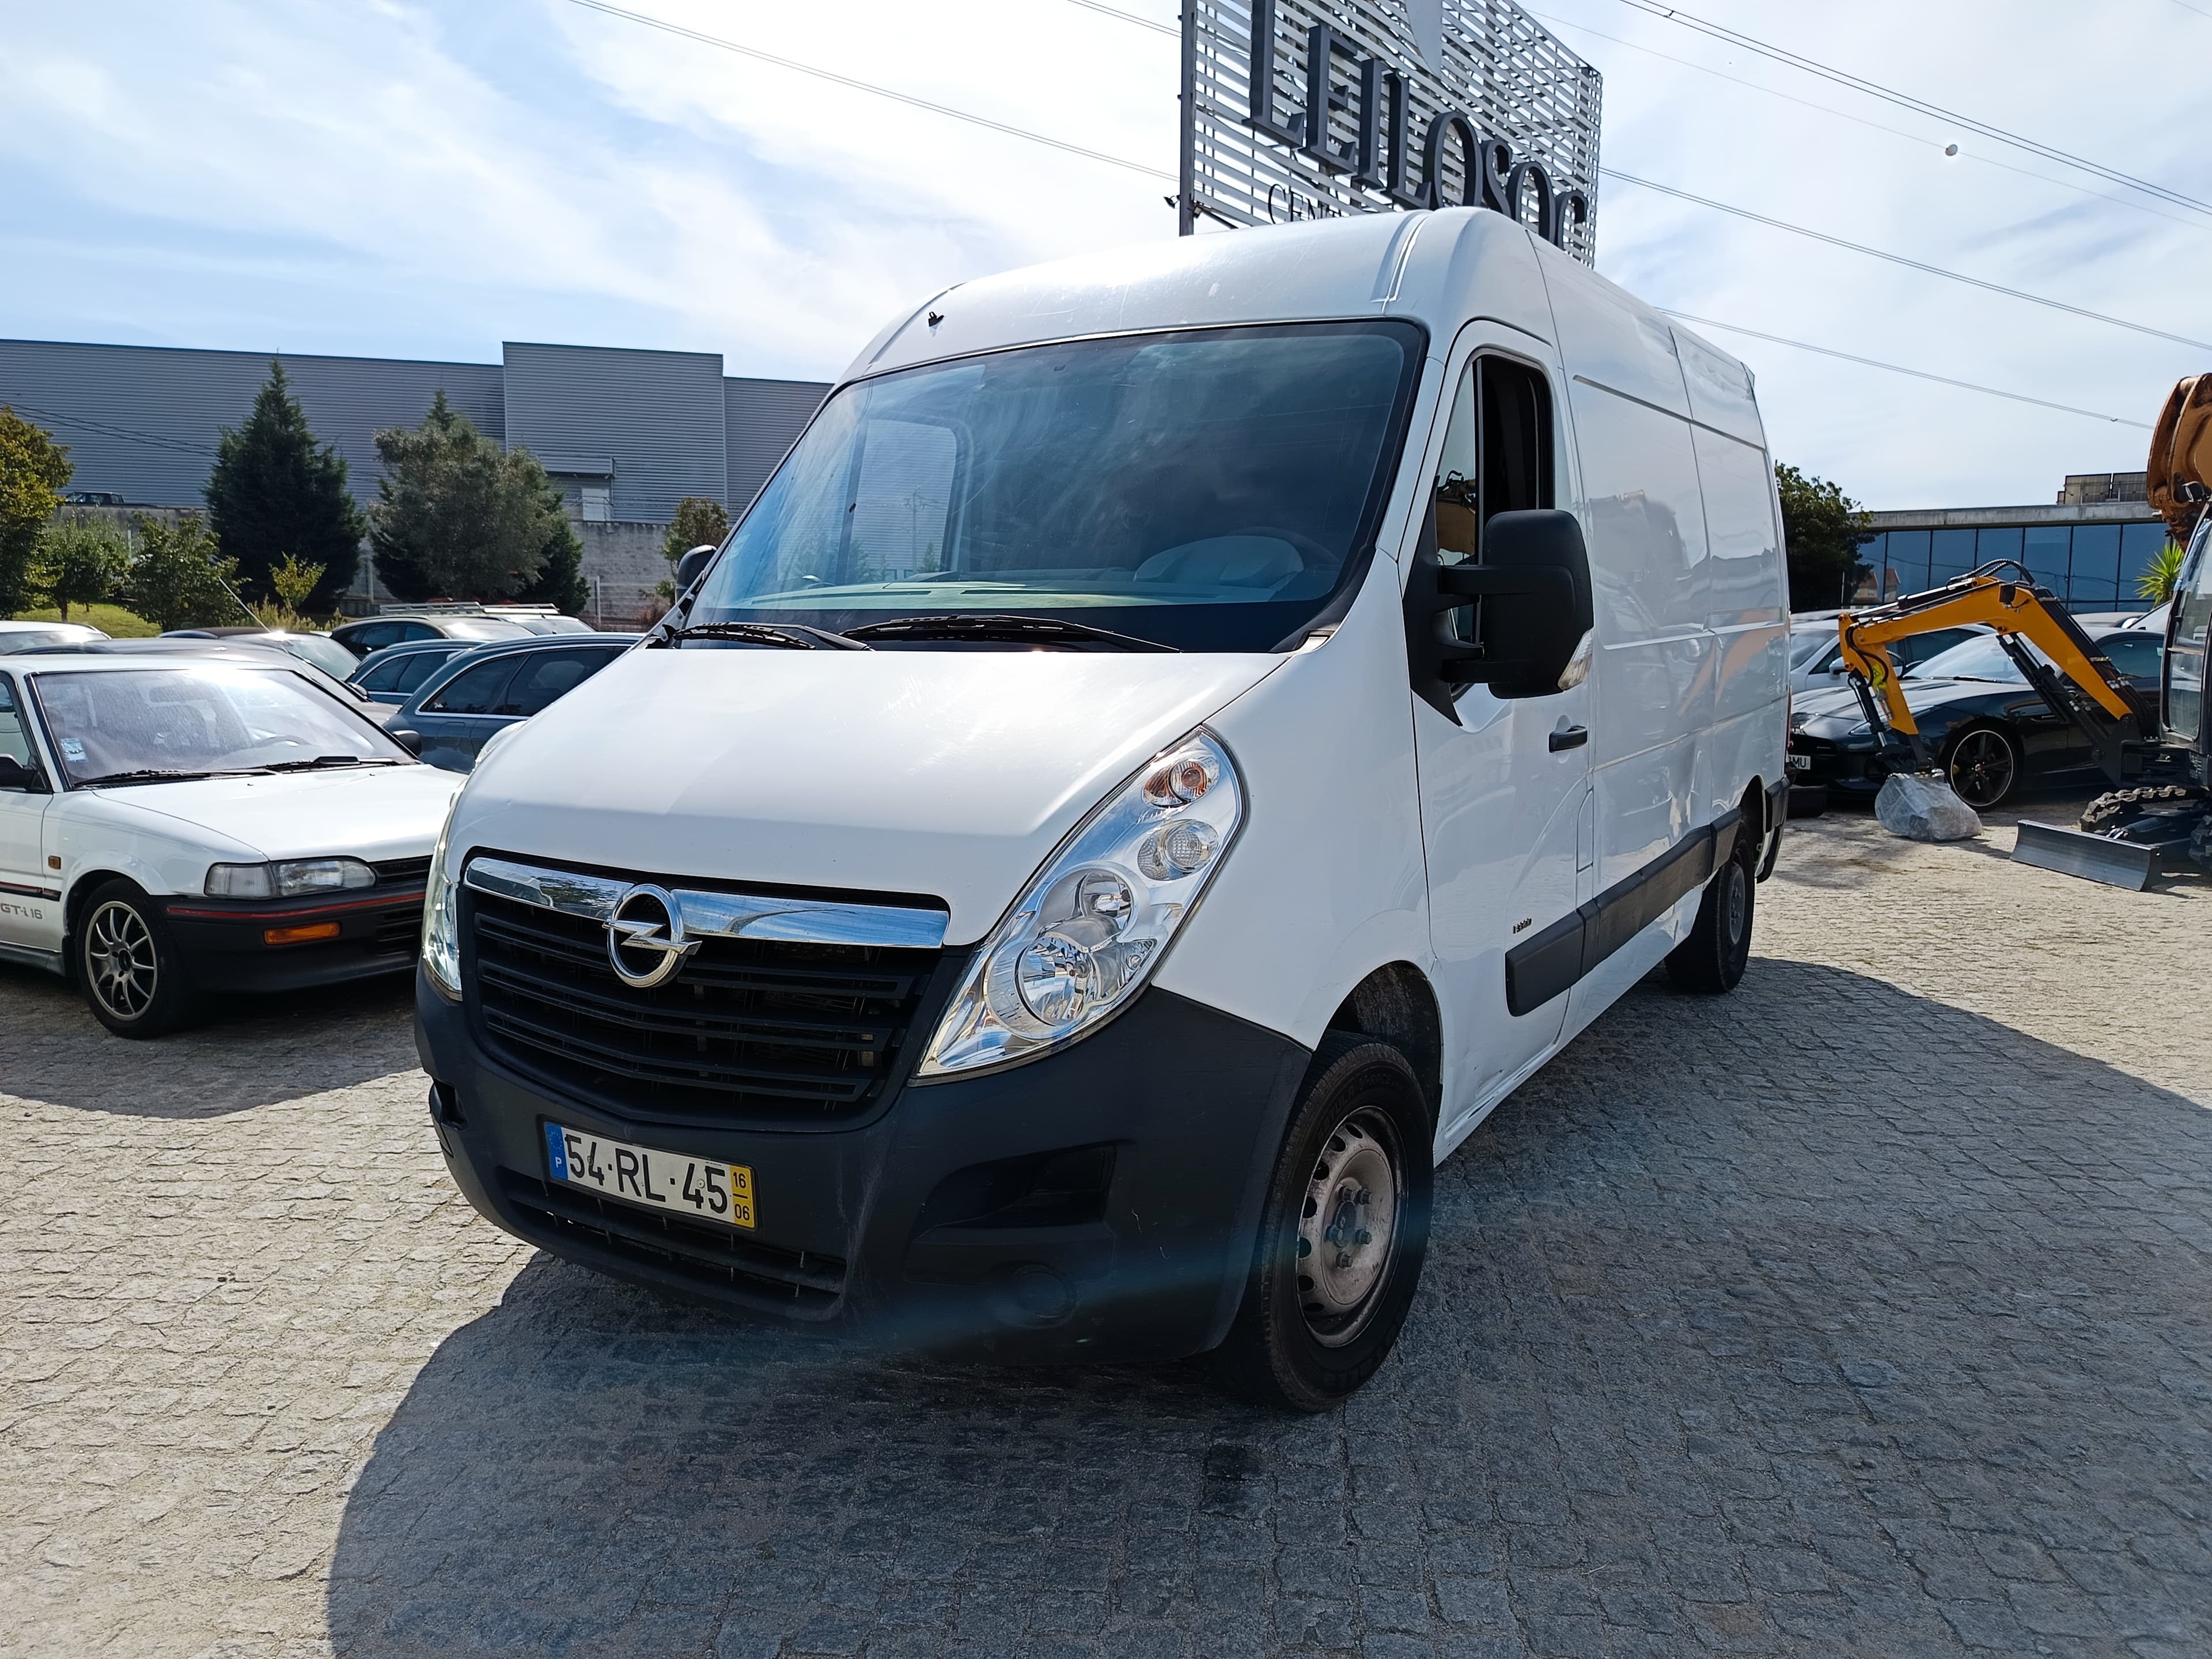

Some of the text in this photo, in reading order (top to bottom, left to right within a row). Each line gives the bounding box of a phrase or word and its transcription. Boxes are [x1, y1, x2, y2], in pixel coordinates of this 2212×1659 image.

[30, 908, 43, 919] 16
[555, 1157, 562, 1168] P
[733, 1172, 747, 1188] 16
[734, 1203, 750, 1221] 06
